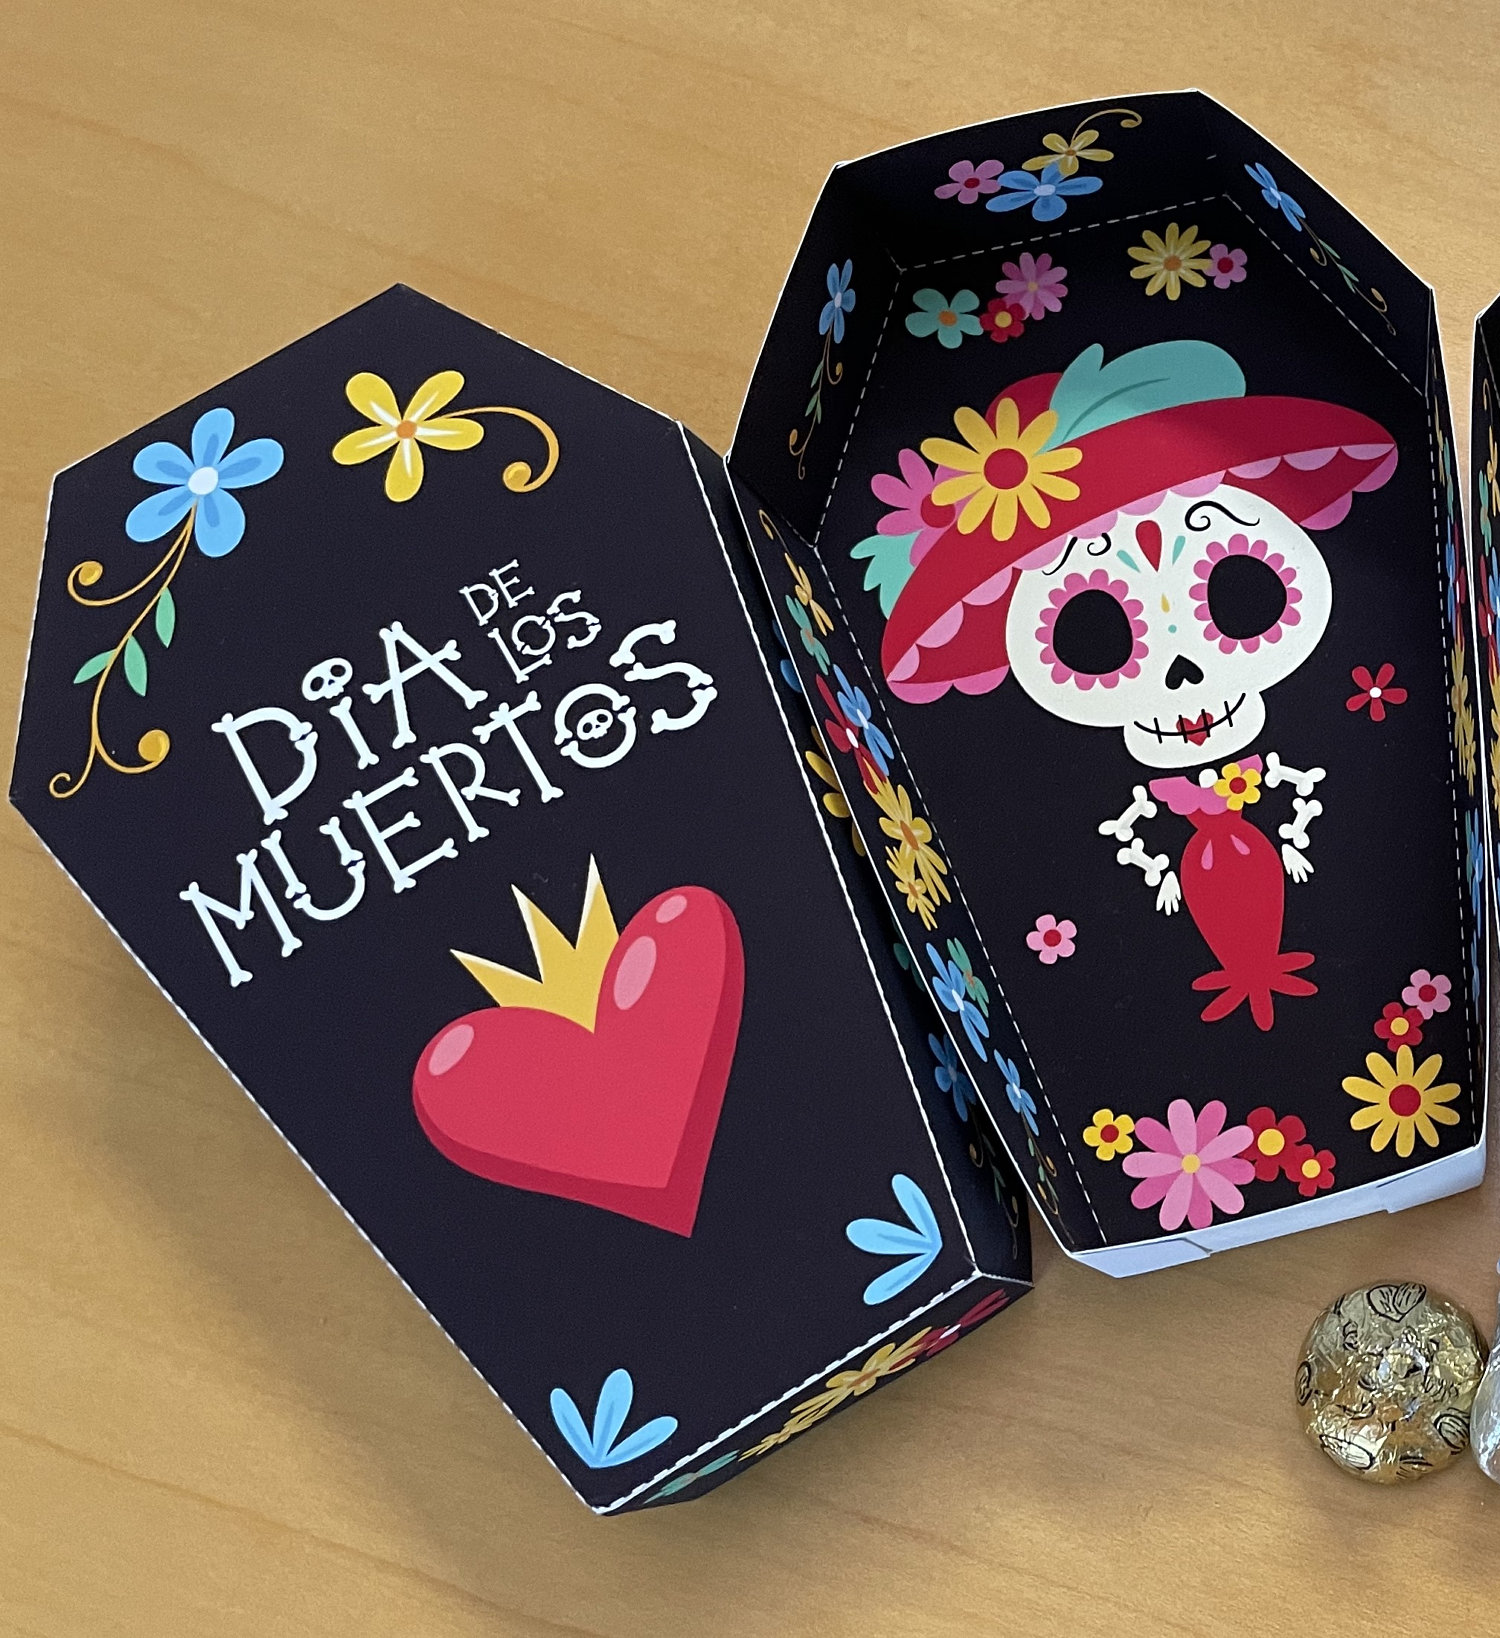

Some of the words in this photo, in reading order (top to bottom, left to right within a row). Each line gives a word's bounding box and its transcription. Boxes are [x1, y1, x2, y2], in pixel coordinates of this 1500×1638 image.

[459, 559, 534, 626] DE
[488, 590, 602, 684] LOS
[180, 620, 718, 987] MUERTOS
